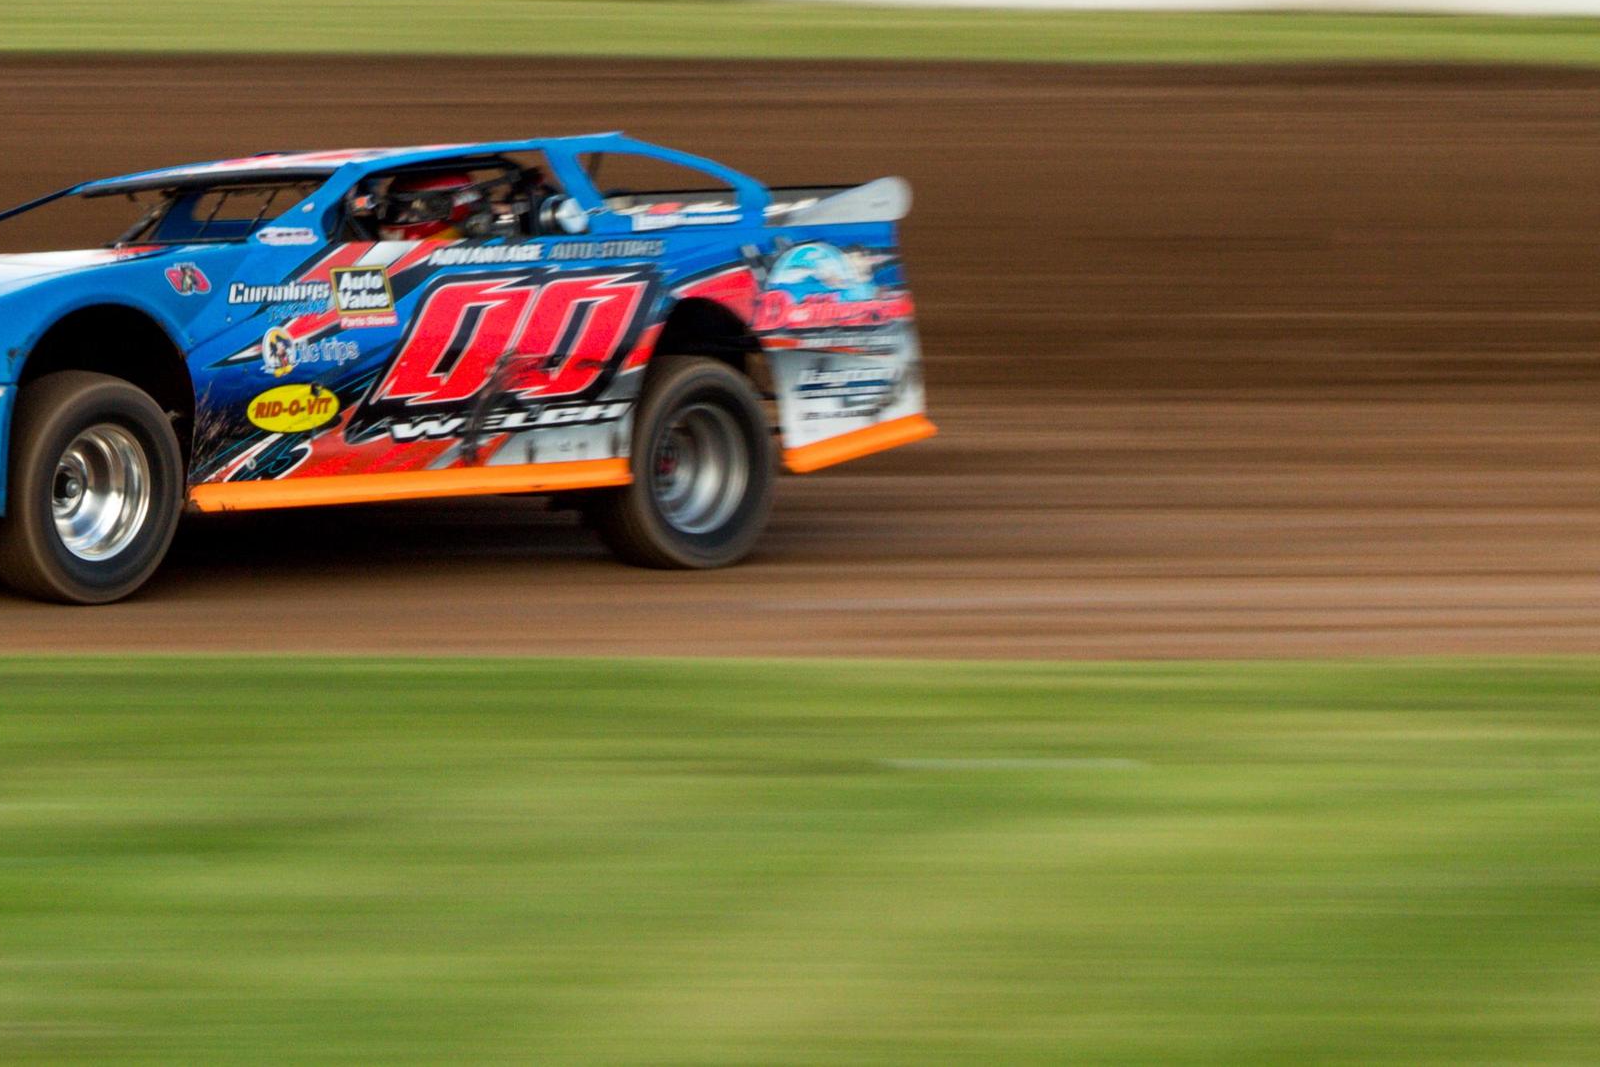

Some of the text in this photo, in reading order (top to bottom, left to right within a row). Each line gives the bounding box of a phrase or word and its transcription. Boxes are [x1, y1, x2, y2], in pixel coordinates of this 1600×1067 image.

[428, 244, 545, 266] ADVANTAGE
[338, 271, 385, 290] Auto
[228, 280, 331, 304] Cummings
[338, 290, 390, 309] Value
[369, 272, 649, 405] 00
[254, 397, 332, 419] RID-O-VIT
[391, 402, 634, 439] WELCH
